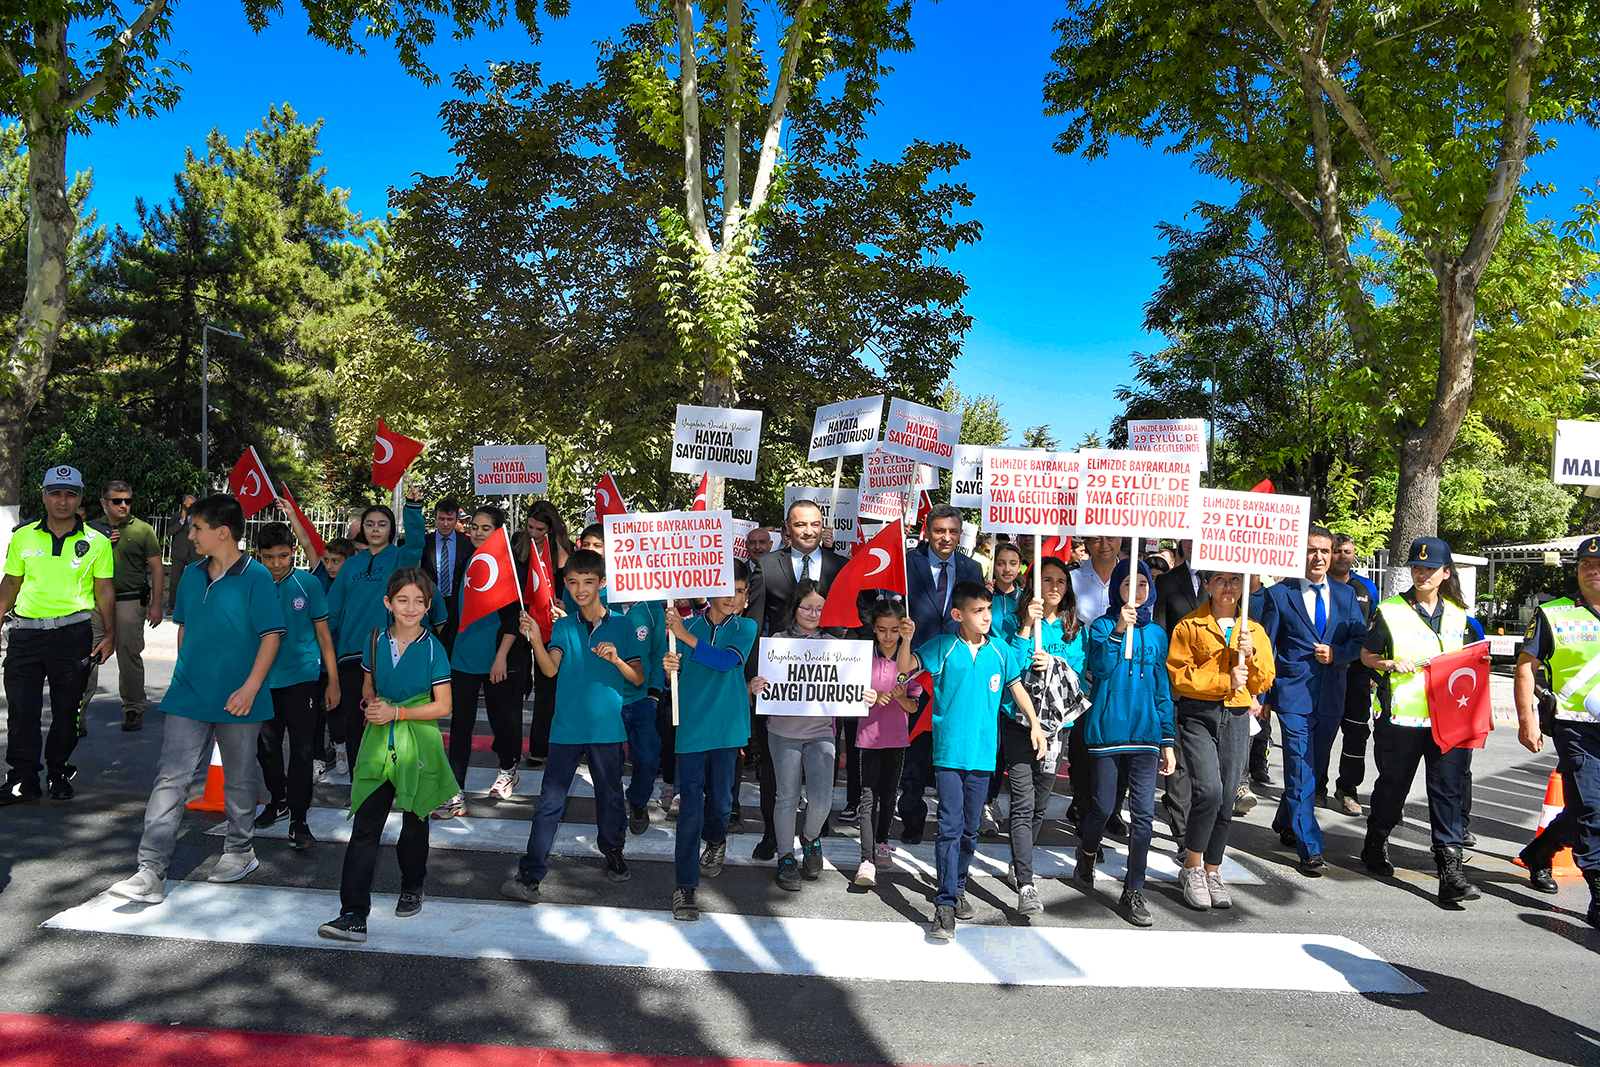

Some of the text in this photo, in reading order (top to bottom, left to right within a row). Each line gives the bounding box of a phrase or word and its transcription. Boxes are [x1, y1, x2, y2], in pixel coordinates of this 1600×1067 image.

[828, 417, 858, 434] HAYATA
[906, 421, 938, 440] HAYATA
[695, 430, 733, 447] HAYATA
[813, 428, 874, 449] SAYGI DURUŞU
[889, 430, 953, 458] SAYGI DURUŞU
[1134, 435, 1147, 443] 29
[676, 443, 752, 465] SAYGI DURUŞU
[868, 457, 880, 465] 29
[492, 462, 525, 472] HAYATA
[868, 466, 885, 475] YAYA
[1130, 460, 1190, 474] BAYRAKLARLA
[478, 472, 542, 484] SAYGI DURUŞU
[990, 473, 1009, 486] 29
[1087, 474, 1107, 488] 29
[862, 494, 875, 504] YAYA
[990, 489, 1015, 503] YAYA
[1086, 490, 1112, 504] YAYA
[1243, 500, 1300, 515] BAYRAKLARLA
[657, 518, 722, 532] BAYRAKLARLA
[1202, 512, 1221, 524] 29
[1201, 527, 1226, 541] YAYA
[614, 538, 635, 553] 29
[614, 555, 642, 570] YAYA
[788, 664, 838, 682] HAYATA
[761, 682, 864, 704] SAYGI DURUŞU
